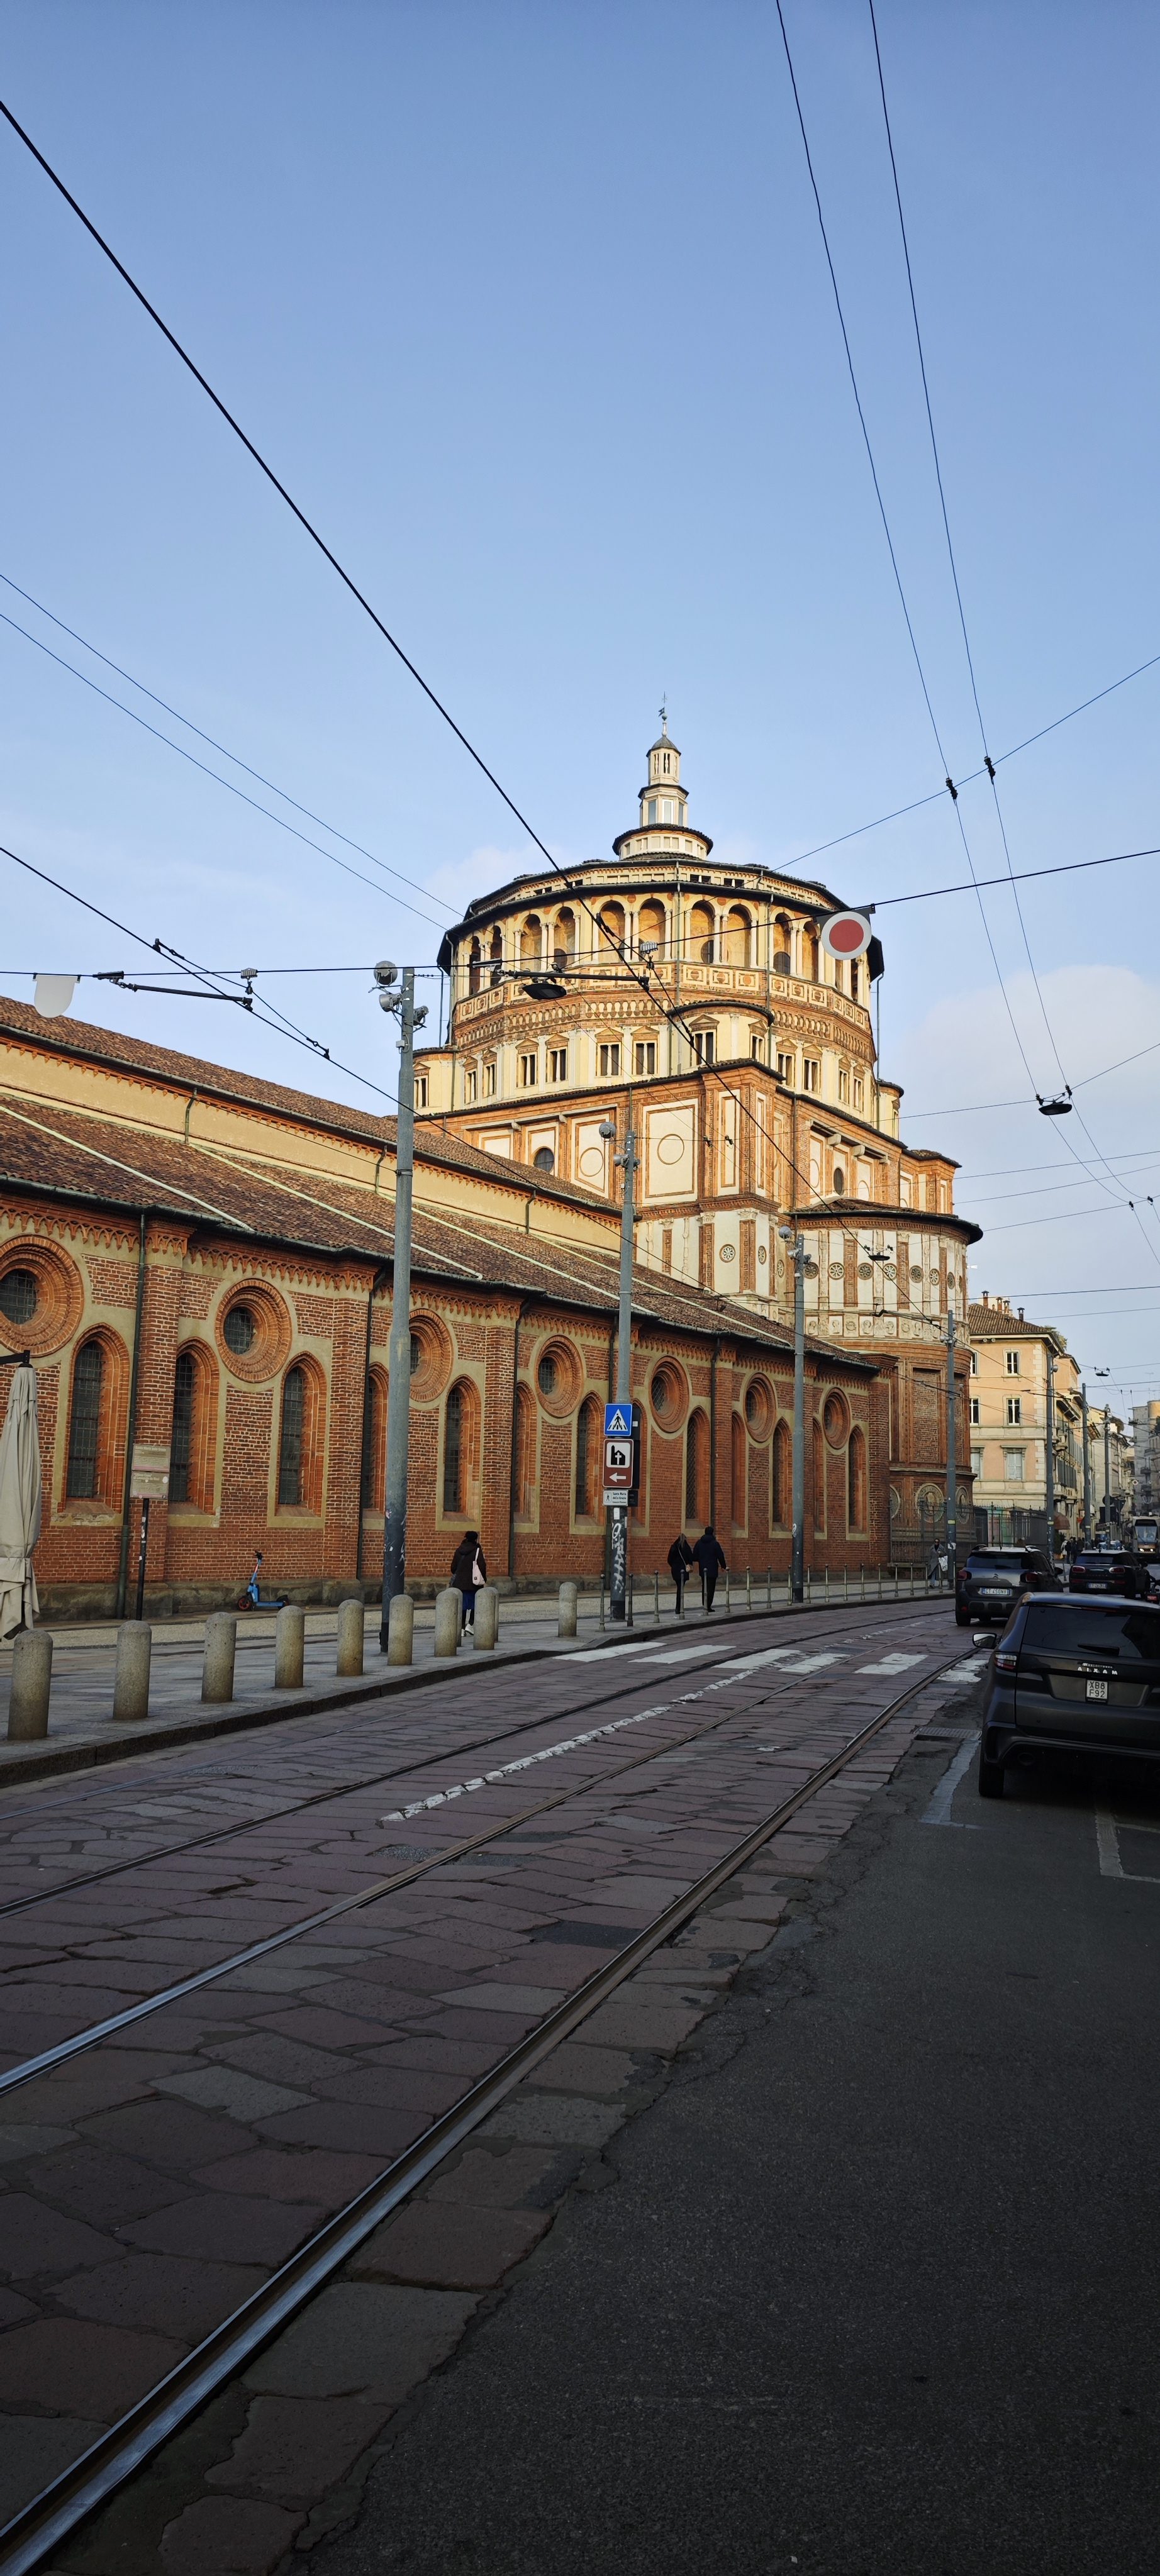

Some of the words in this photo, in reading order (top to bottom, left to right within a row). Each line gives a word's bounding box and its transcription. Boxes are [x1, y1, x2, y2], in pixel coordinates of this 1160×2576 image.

[1077, 1667, 1118, 1675] AIXAM
[1090, 1681, 1105, 1689] XB8
[1090, 1689, 1105, 1697] F92
